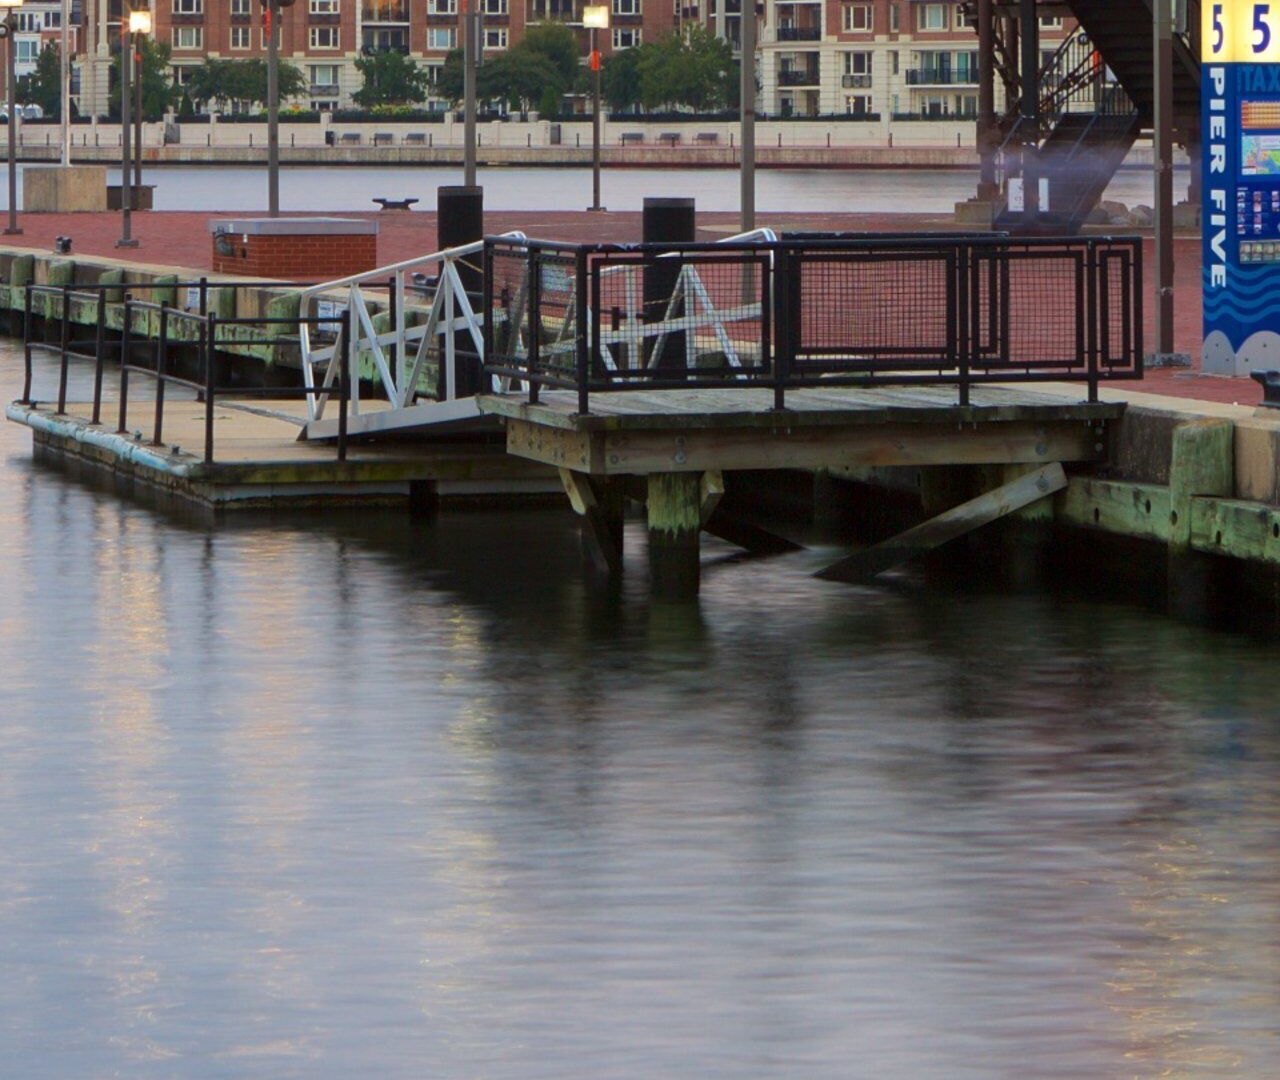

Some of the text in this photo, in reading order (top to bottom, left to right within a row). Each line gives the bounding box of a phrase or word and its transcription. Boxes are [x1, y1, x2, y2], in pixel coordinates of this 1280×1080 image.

[1212, 4, 1223, 53] 5
[1252, 4, 1271, 53] 5
[1210, 67, 1226, 287] PIER FIVE
